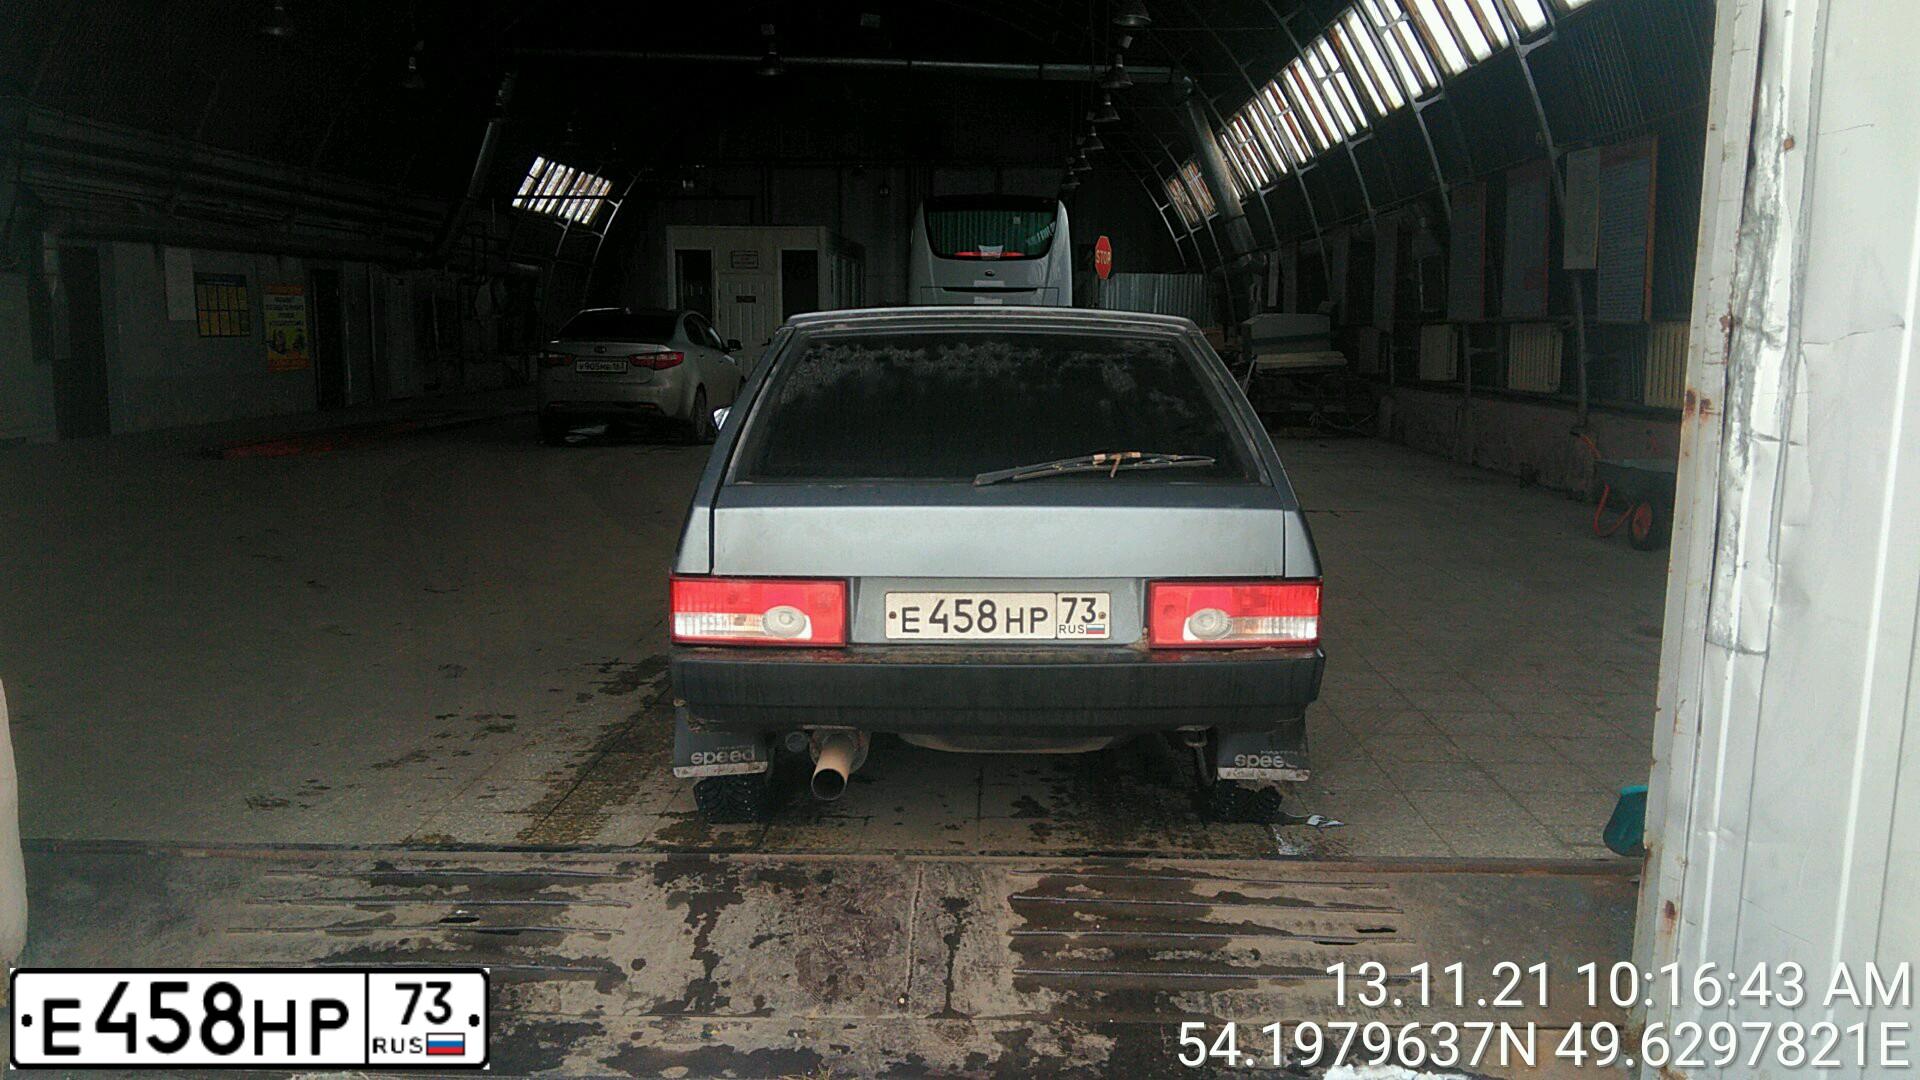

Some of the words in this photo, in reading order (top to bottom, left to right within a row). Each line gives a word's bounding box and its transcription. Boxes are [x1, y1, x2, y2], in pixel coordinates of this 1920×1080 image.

[1095, 249, 1111, 265] STOP
[1061, 597, 1097, 625] 73
[1058, 623, 1085, 635] RUS
